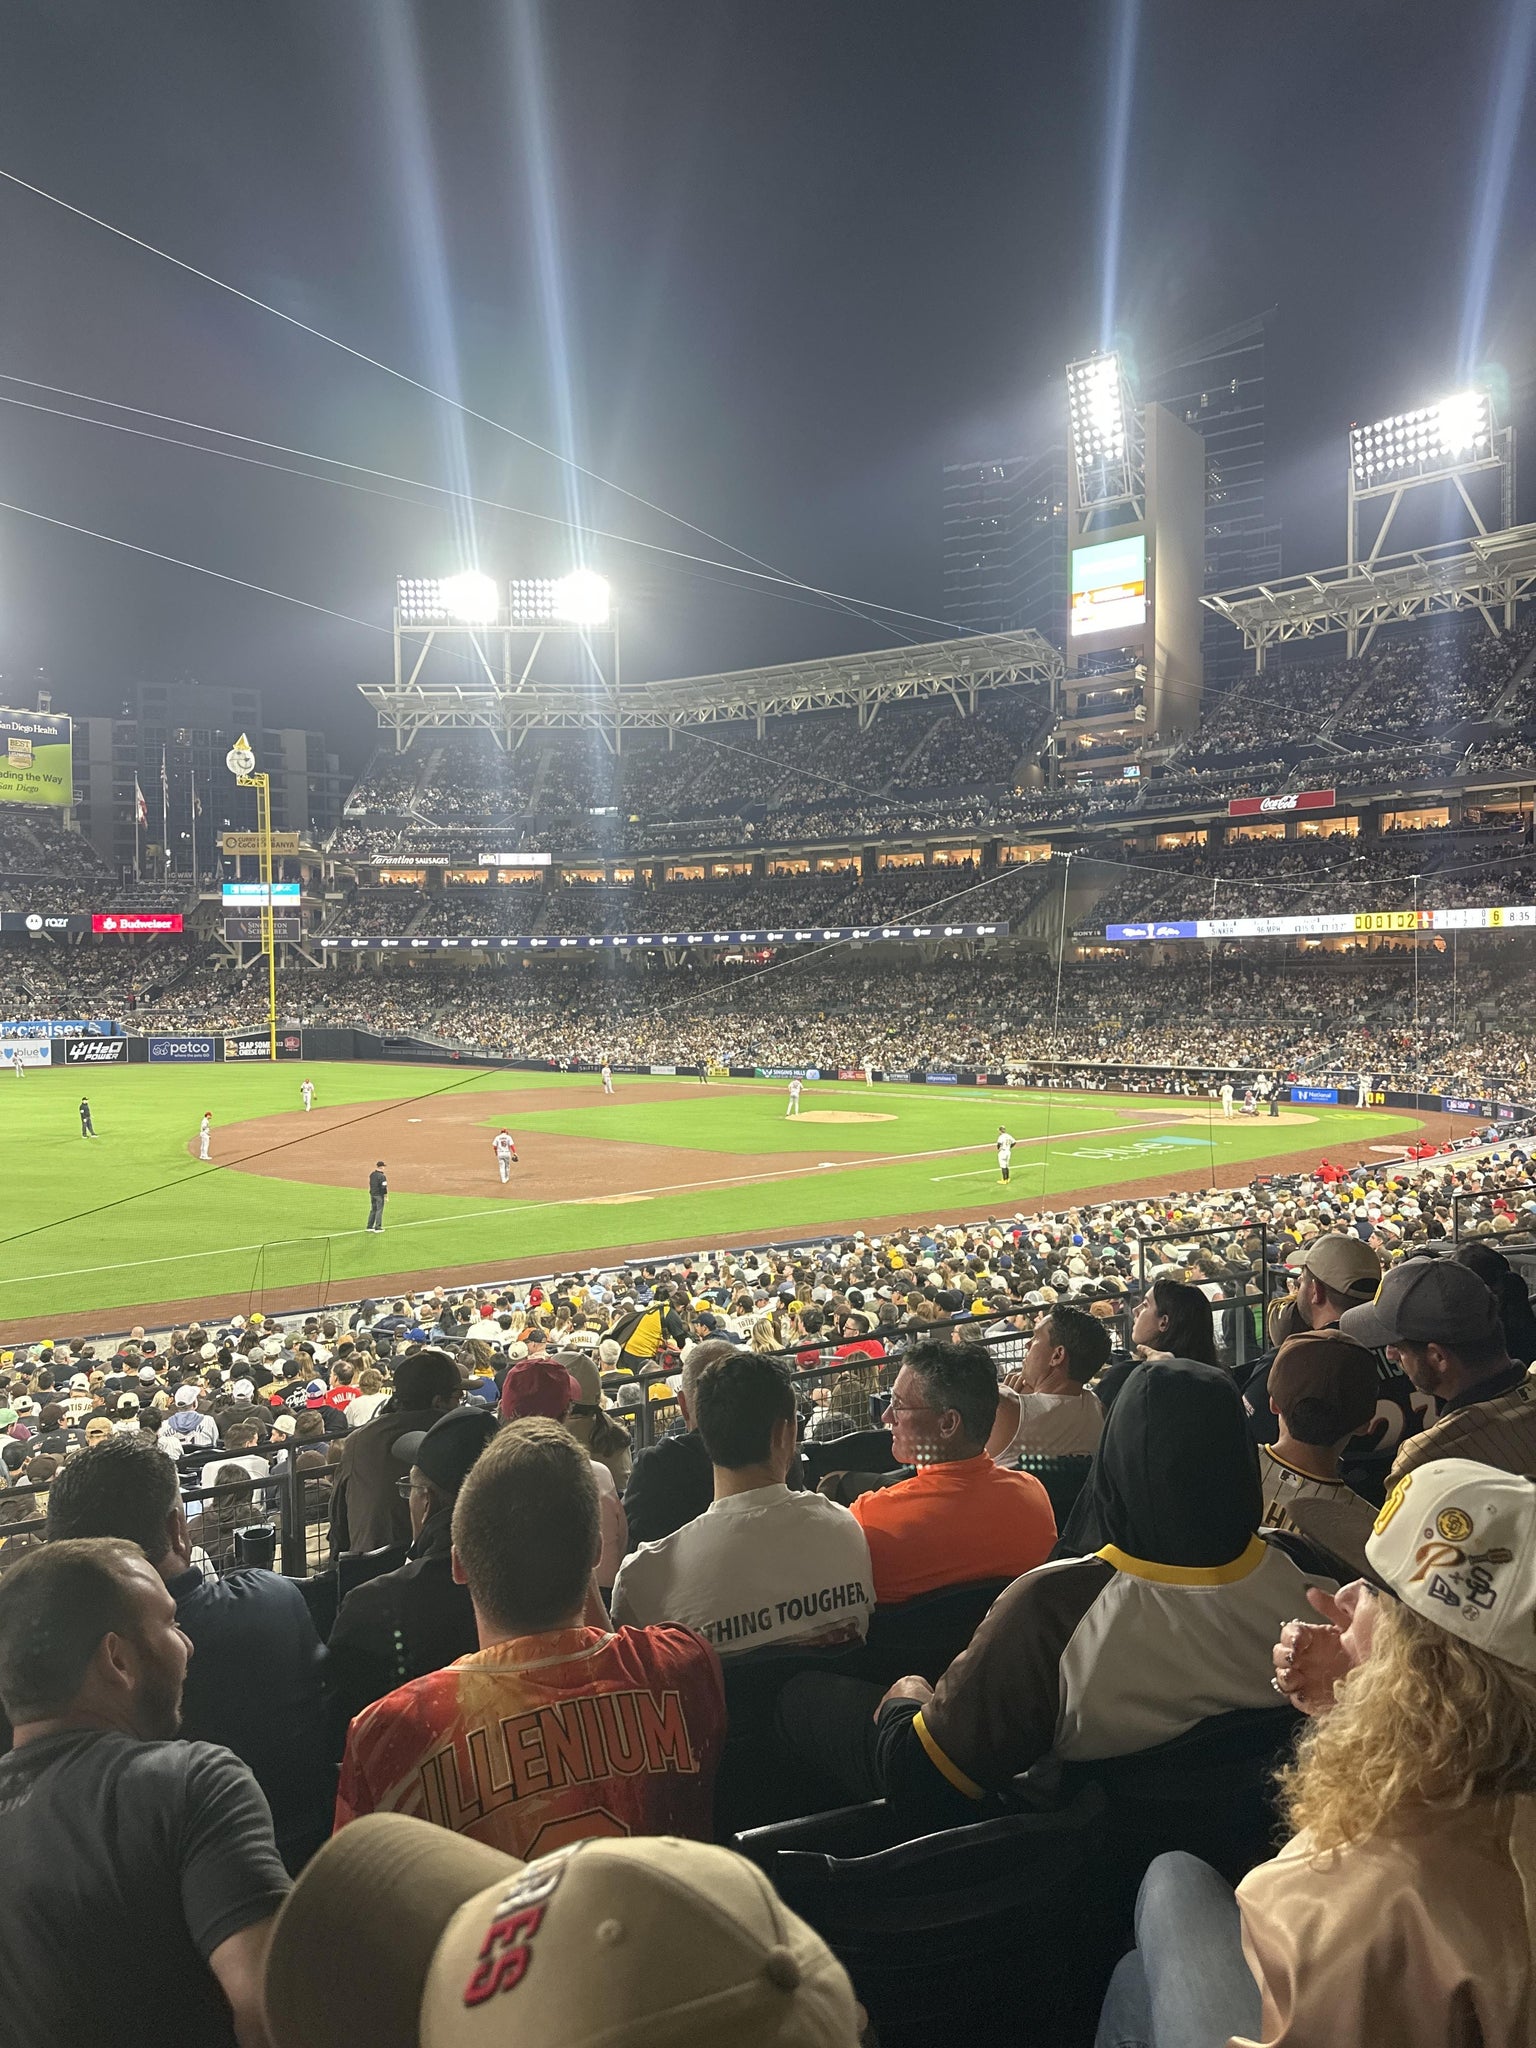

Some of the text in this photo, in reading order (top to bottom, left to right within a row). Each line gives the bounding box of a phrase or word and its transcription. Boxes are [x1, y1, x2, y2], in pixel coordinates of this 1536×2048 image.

[11, 722, 33, 734] Diego
[33, 724, 58, 735] Health
[26, 772, 41, 781] the
[43, 774, 63, 785] Way
[16, 783, 39, 794] Diego
[371, 854, 449, 865] Tarantino SAUSAGES
[1387, 914, 1391, 928] 1
[1407, 913, 1415, 928] 2
[1493, 910, 1500, 922] 6
[45, 918, 69, 928] razr
[120, 918, 173, 929] Budweiser
[170, 1041, 210, 1056] petco
[239, 1041, 254, 1050] SLAP
[254, 1041, 271, 1049] SOME
[84, 1053, 119, 1061] POWER
[700, 1582, 870, 1644] THING TOUGHER,
